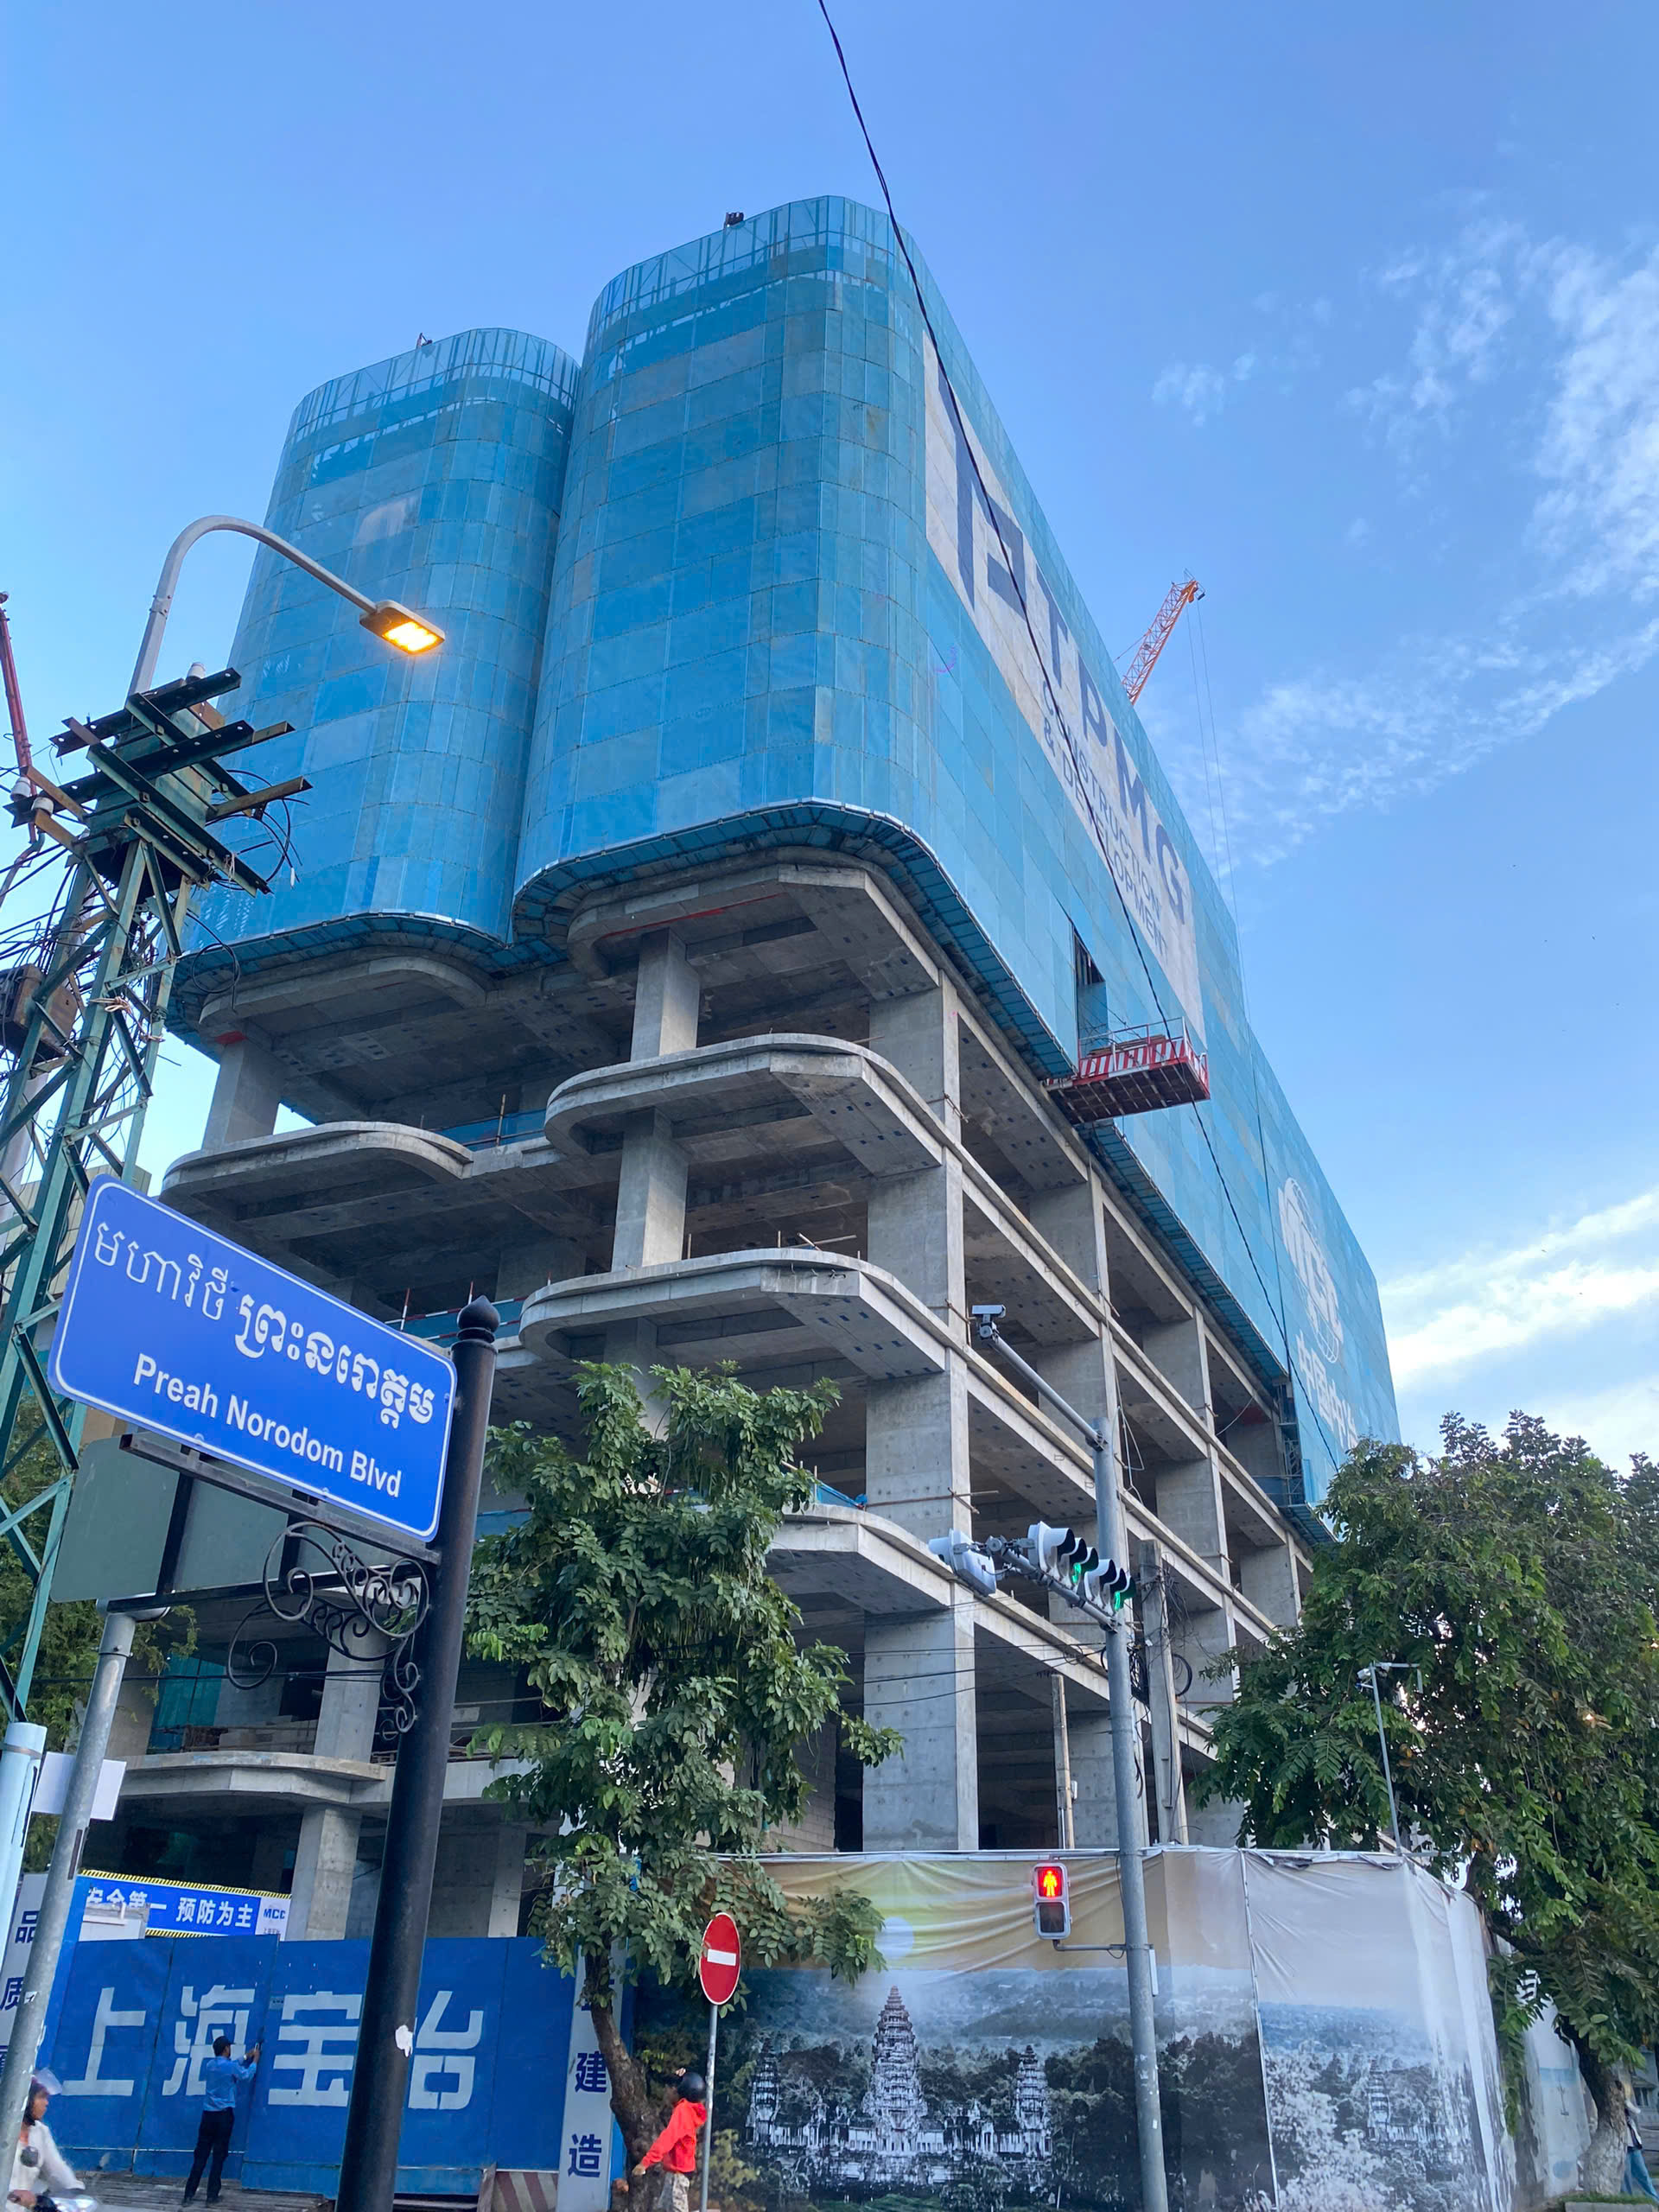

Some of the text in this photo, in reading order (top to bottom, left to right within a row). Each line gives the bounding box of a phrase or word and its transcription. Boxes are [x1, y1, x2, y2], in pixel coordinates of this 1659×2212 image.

[1037, 562, 1185, 925] TPMG
[1043, 680, 1160, 921] CONSTRUCTION
[1062, 747, 1168, 958] DEVELOPMENT
[133, 1353, 402, 1497] Preah Norodom Blvd
[175, 1897, 253, 1929] 预防为主
